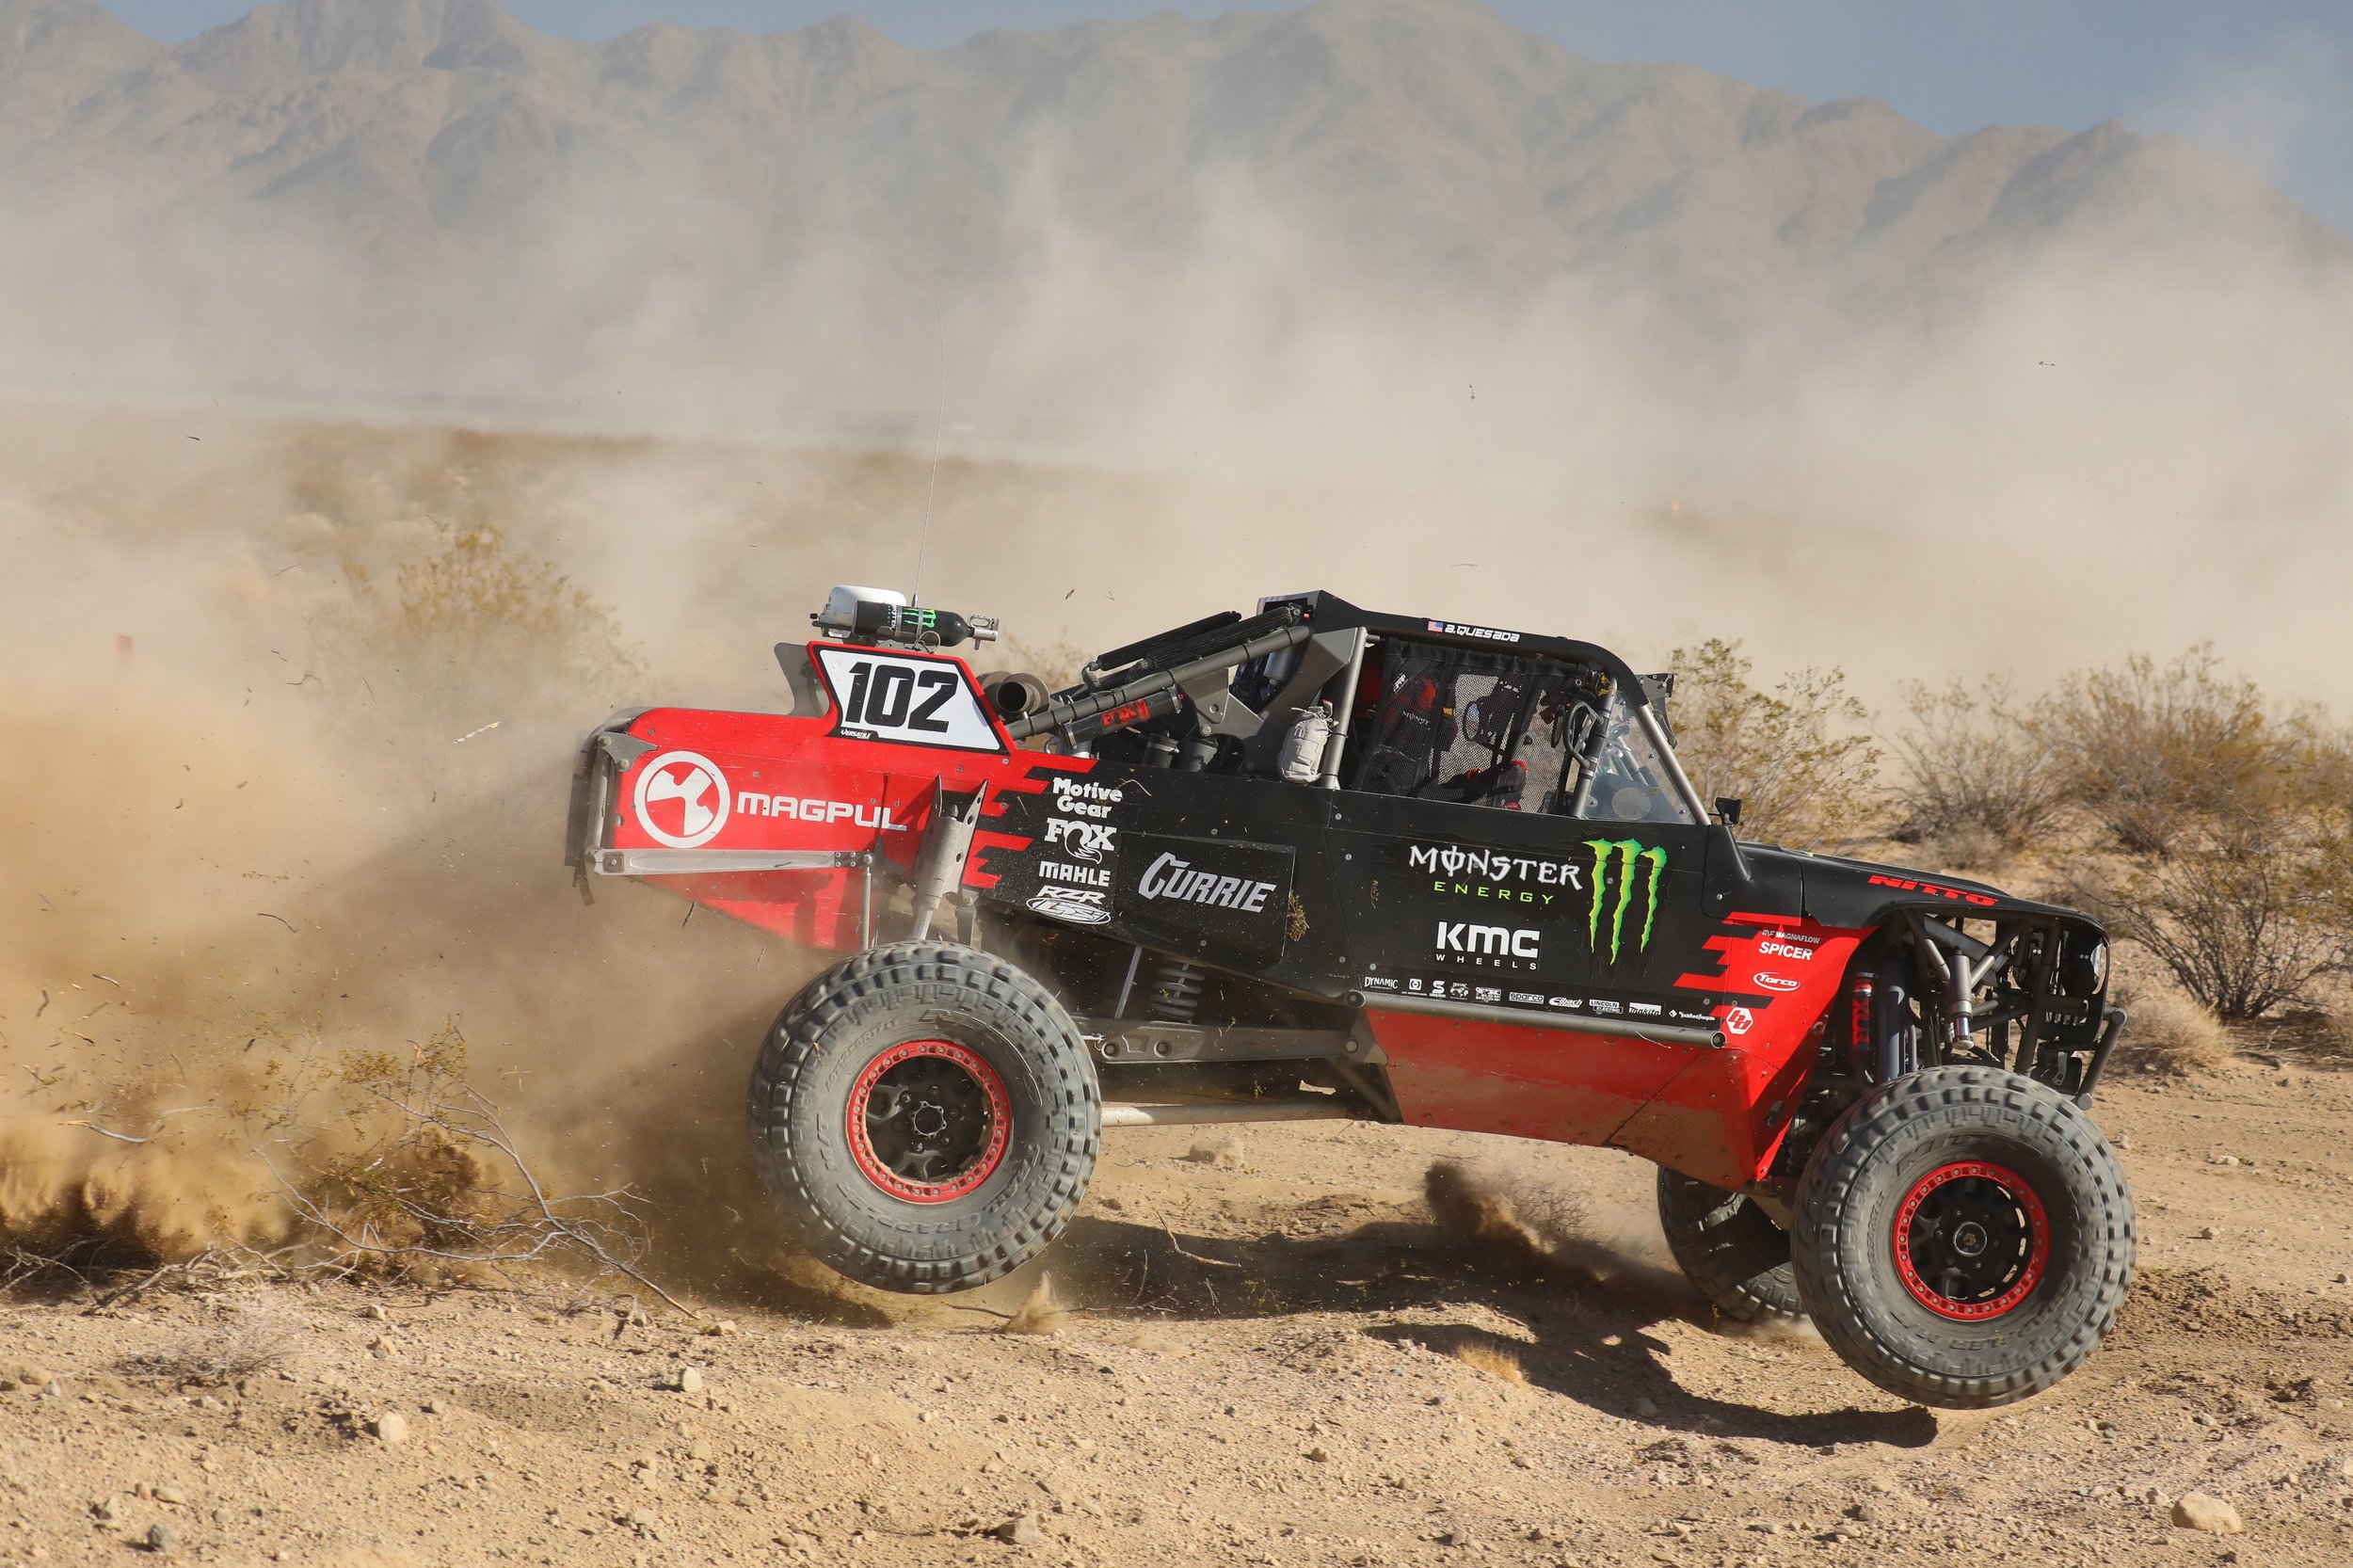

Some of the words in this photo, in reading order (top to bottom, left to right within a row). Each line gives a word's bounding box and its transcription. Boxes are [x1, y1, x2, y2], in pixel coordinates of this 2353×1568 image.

[844, 661, 959, 733] 102
[1052, 776, 1123, 803] Motive
[736, 791, 907, 832] MAGPUL
[1056, 795, 1112, 819] Gear
[1044, 817, 1117, 858] FOX
[1038, 860, 1112, 888] MAHLE
[1409, 845, 1583, 890] MONSTER
[1036, 885, 1107, 904] RZR
[1138, 851, 1277, 913] CURRIE
[1433, 881, 1554, 904] ENERGY
[1867, 874, 2000, 906] NITTO
[1436, 921, 1541, 958] KMC
[1775, 930, 1820, 944] MAGNAFLOW
[1435, 953, 1537, 970] WHEELS
[1758, 941, 1813, 960] SPICER
[1364, 976, 1399, 989] DYNAMIC
[1510, 992, 1544, 1002] sparco
[1590, 1000, 1619, 1008] LINCOLN
